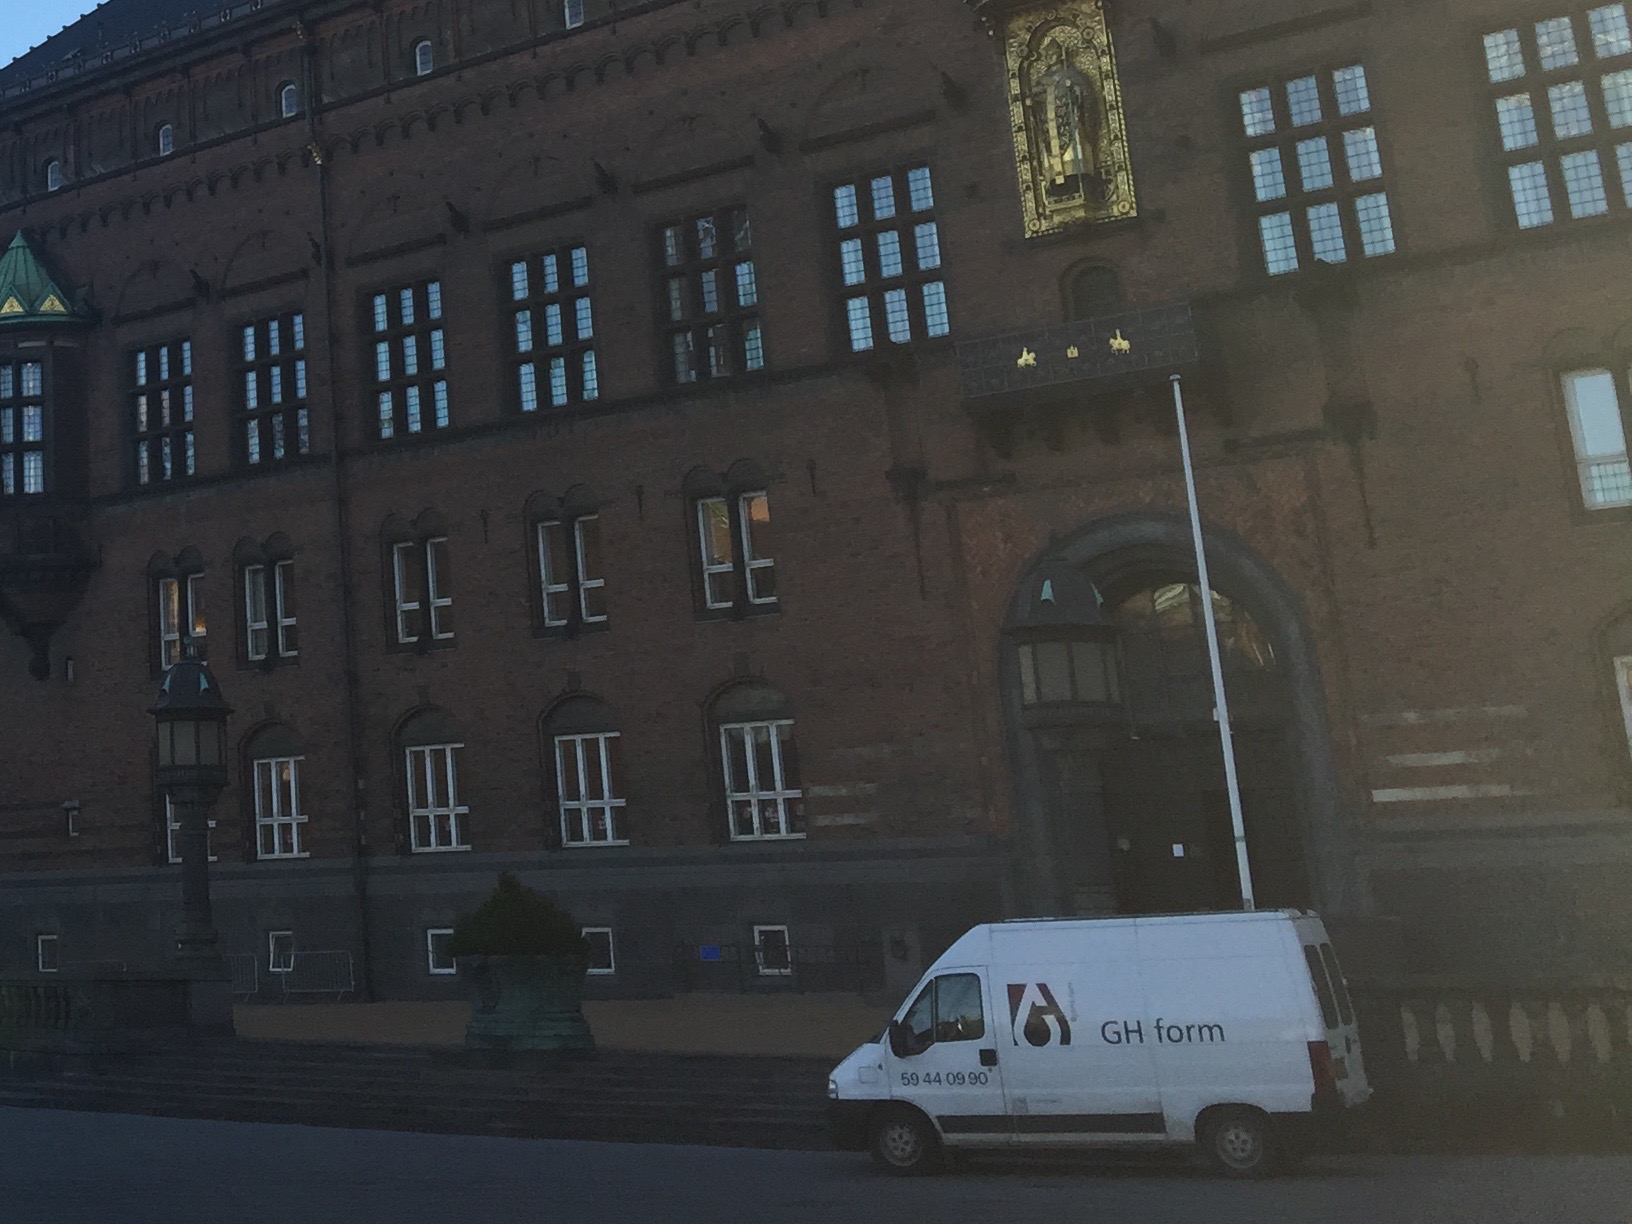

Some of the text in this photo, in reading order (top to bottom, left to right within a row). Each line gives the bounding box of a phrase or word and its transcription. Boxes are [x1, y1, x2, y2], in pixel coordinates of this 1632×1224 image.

[1101, 1017, 1226, 1045] GH form
[901, 1071, 989, 1087] 59 44 09 90
